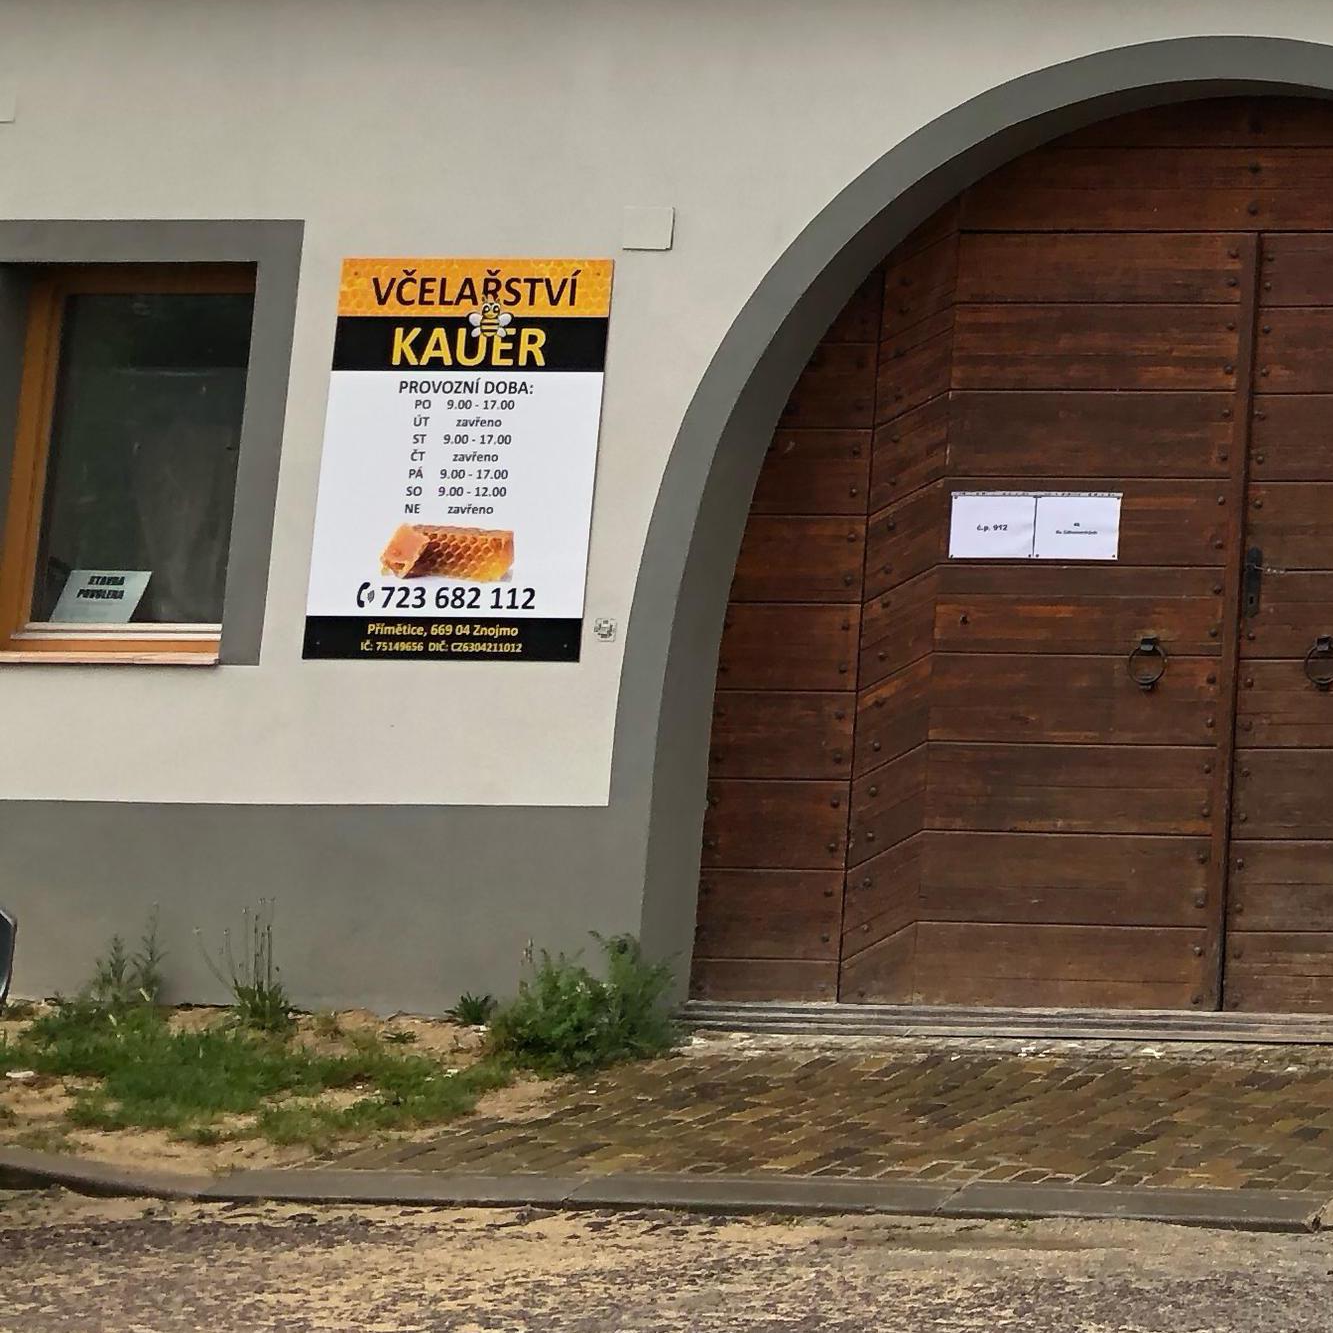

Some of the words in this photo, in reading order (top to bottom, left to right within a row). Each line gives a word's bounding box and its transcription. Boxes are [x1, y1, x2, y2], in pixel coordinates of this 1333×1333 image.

[372, 269, 582, 306] VČELAŘSTVÍ
[391, 327, 547, 366] KAUER
[398, 377, 481, 394] PROVOZNÍ
[484, 381, 534, 395] DOBA:
[414, 399, 431, 410] PO
[446, 399, 472, 410] 9.00
[483, 400, 515, 410] 17.00
[413, 414, 430, 427] ÚT
[455, 417, 502, 428] zavřeno
[412, 434, 427, 444] ST
[443, 434, 469, 445] 9.00
[479, 434, 512, 445] 17.00
[410, 449, 426, 462] ČT
[452, 451, 499, 462] zavřeno
[408, 466, 423, 479] PÁ
[440, 469, 466, 480] 9.00
[476, 469, 508, 480] 17.00
[406, 486, 423, 497] SO
[438, 486, 464, 497] 9.00
[474, 486, 507, 497] 12.00
[404, 504, 421, 514] NE
[447, 504, 494, 515] zavřeno
[381, 586, 426, 609] 723
[435, 586, 481, 609] 682
[490, 587, 536, 610] 112
[367, 623, 428, 637] Přímětice,
[430, 624, 453, 636] 669
[455, 624, 470, 636] 04
[472, 624, 519, 639] Znojmo
